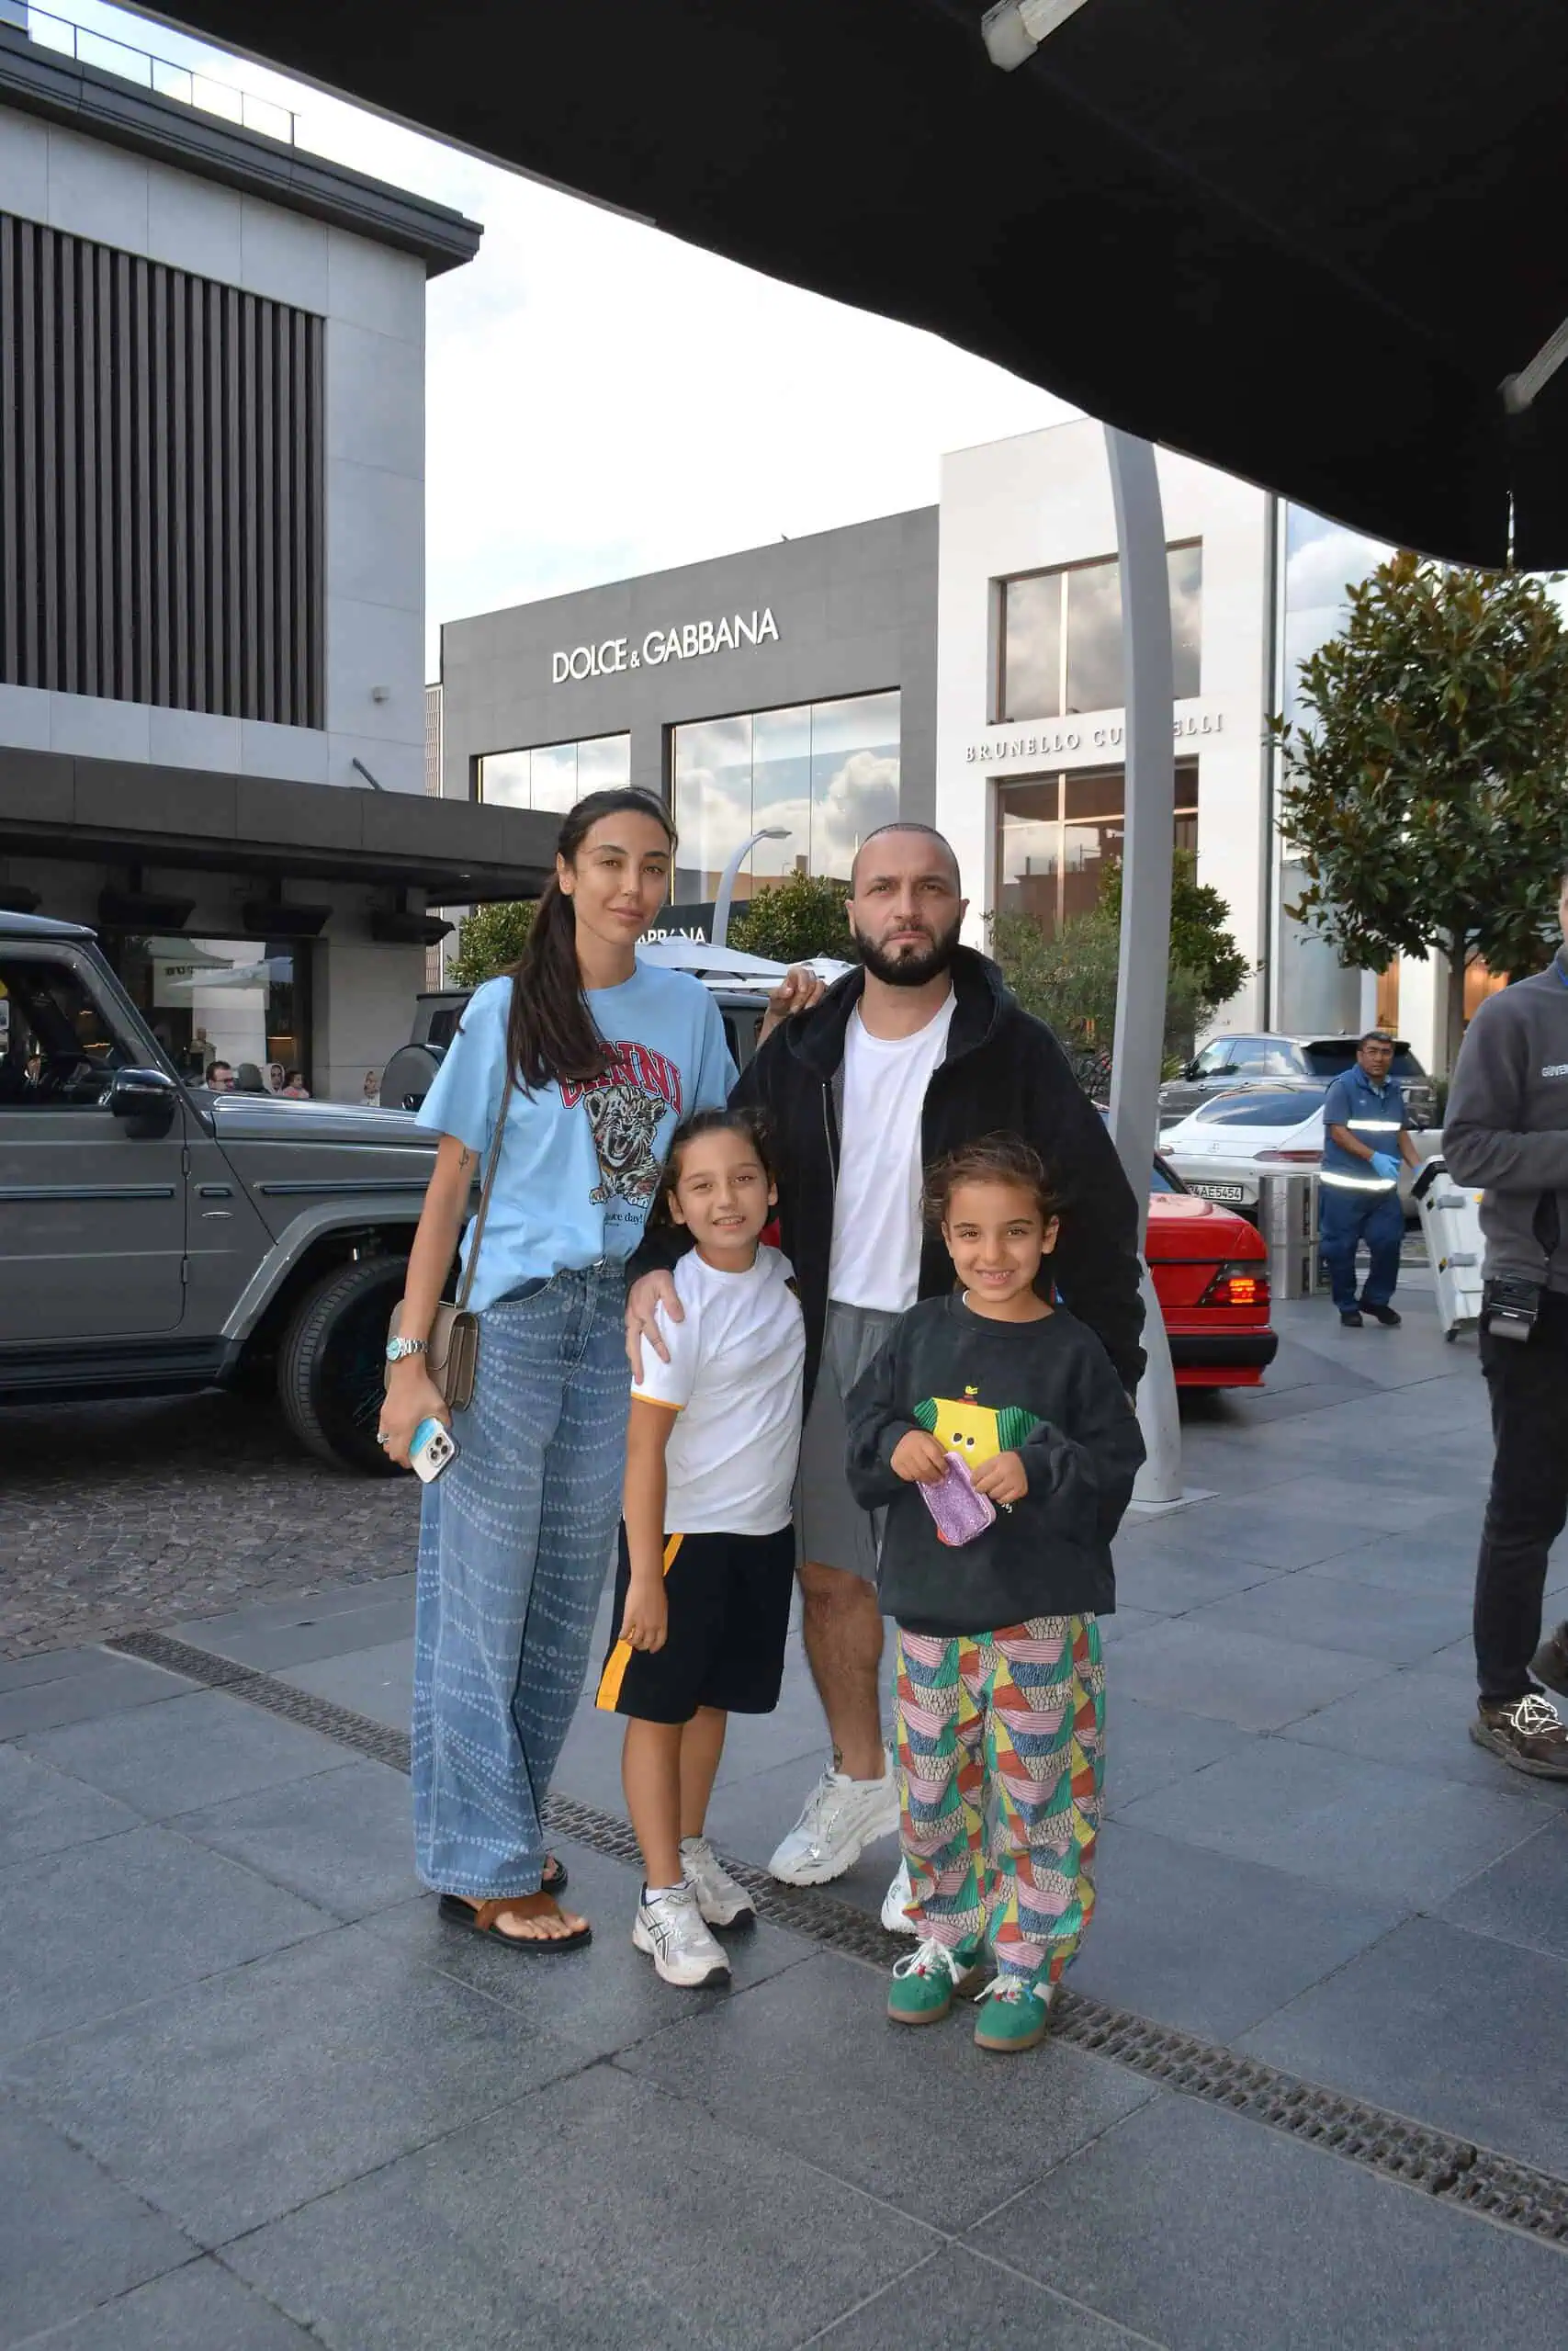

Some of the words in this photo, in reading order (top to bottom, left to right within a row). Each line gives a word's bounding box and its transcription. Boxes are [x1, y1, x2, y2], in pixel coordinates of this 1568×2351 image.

[553, 638, 627, 684] DOLCE
[630, 650, 640, 668] &
[642, 607, 780, 666] GABBANA
[964, 733, 1080, 763] BRUNELLO
[1092, 713, 1224, 747] CUELLI
